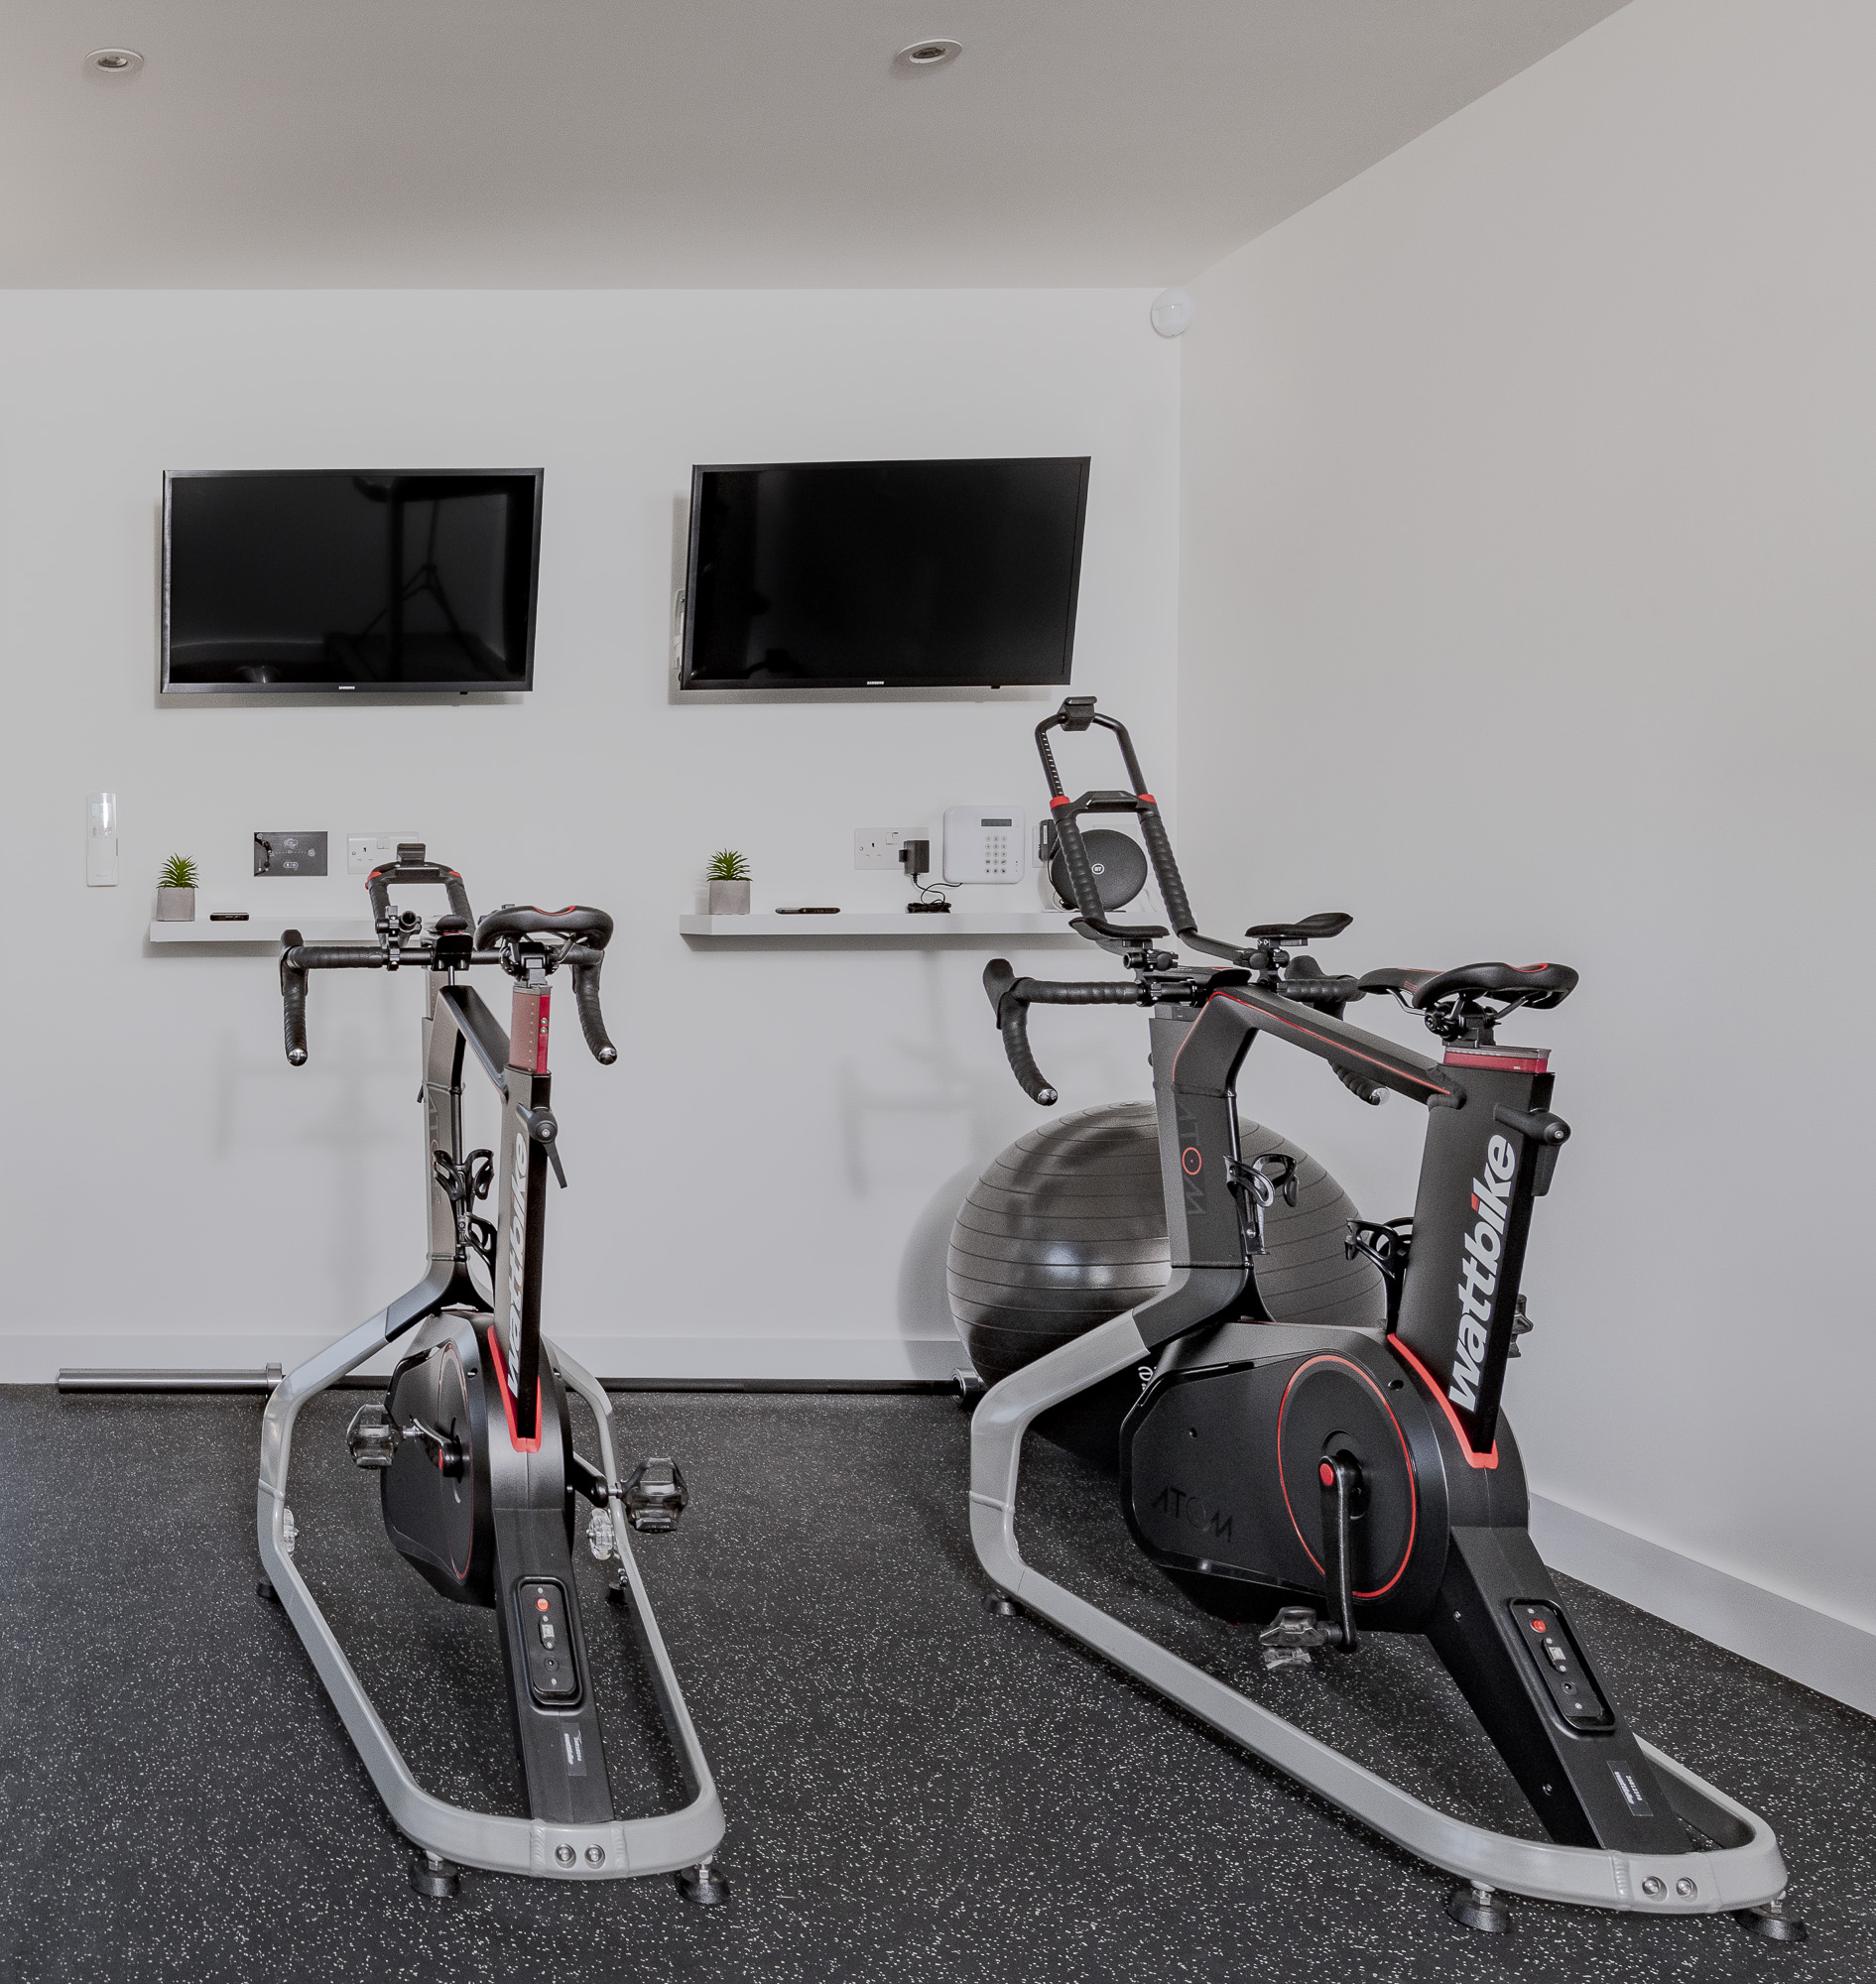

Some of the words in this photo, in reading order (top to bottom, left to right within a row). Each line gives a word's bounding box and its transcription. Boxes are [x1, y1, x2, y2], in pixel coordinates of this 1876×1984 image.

[507, 1132, 529, 1399] wattbike
[1447, 1134, 1516, 1413] wattbike
[1152, 1484, 1233, 1544] ATOM
